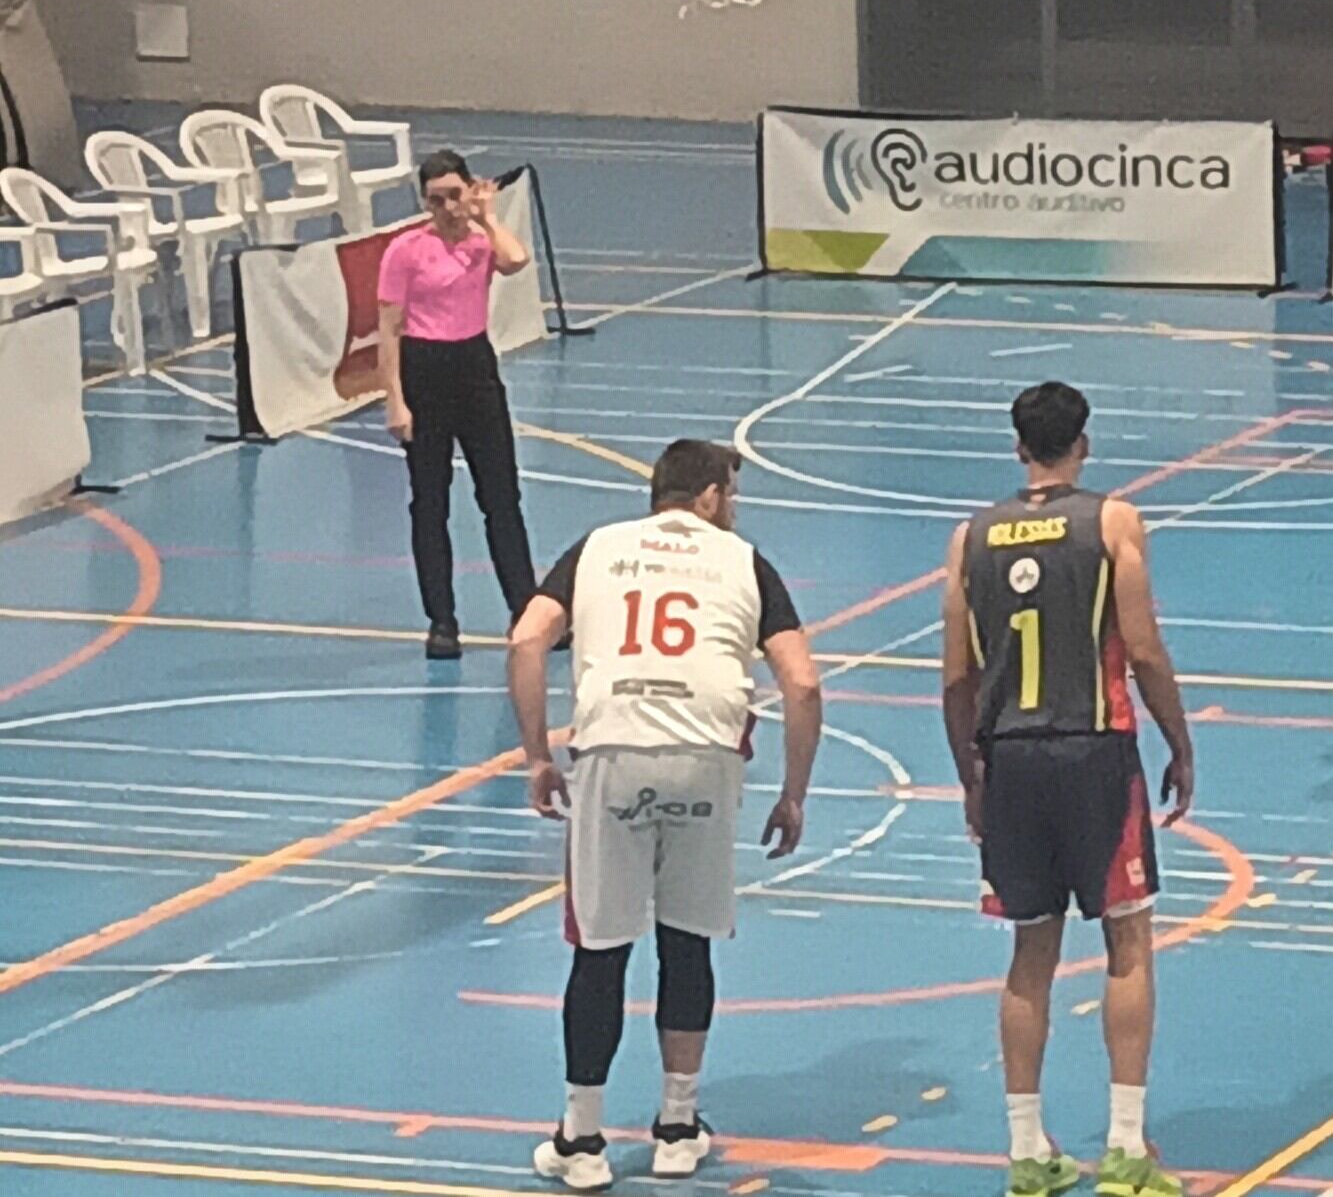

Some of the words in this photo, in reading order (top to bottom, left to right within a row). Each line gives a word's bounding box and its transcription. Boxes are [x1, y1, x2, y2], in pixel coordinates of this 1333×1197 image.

[933, 142, 1232, 190] audiocinca
[939, 191, 1020, 212] centro
[617, 589, 700, 658] 16
[1009, 607, 1041, 711] 1
